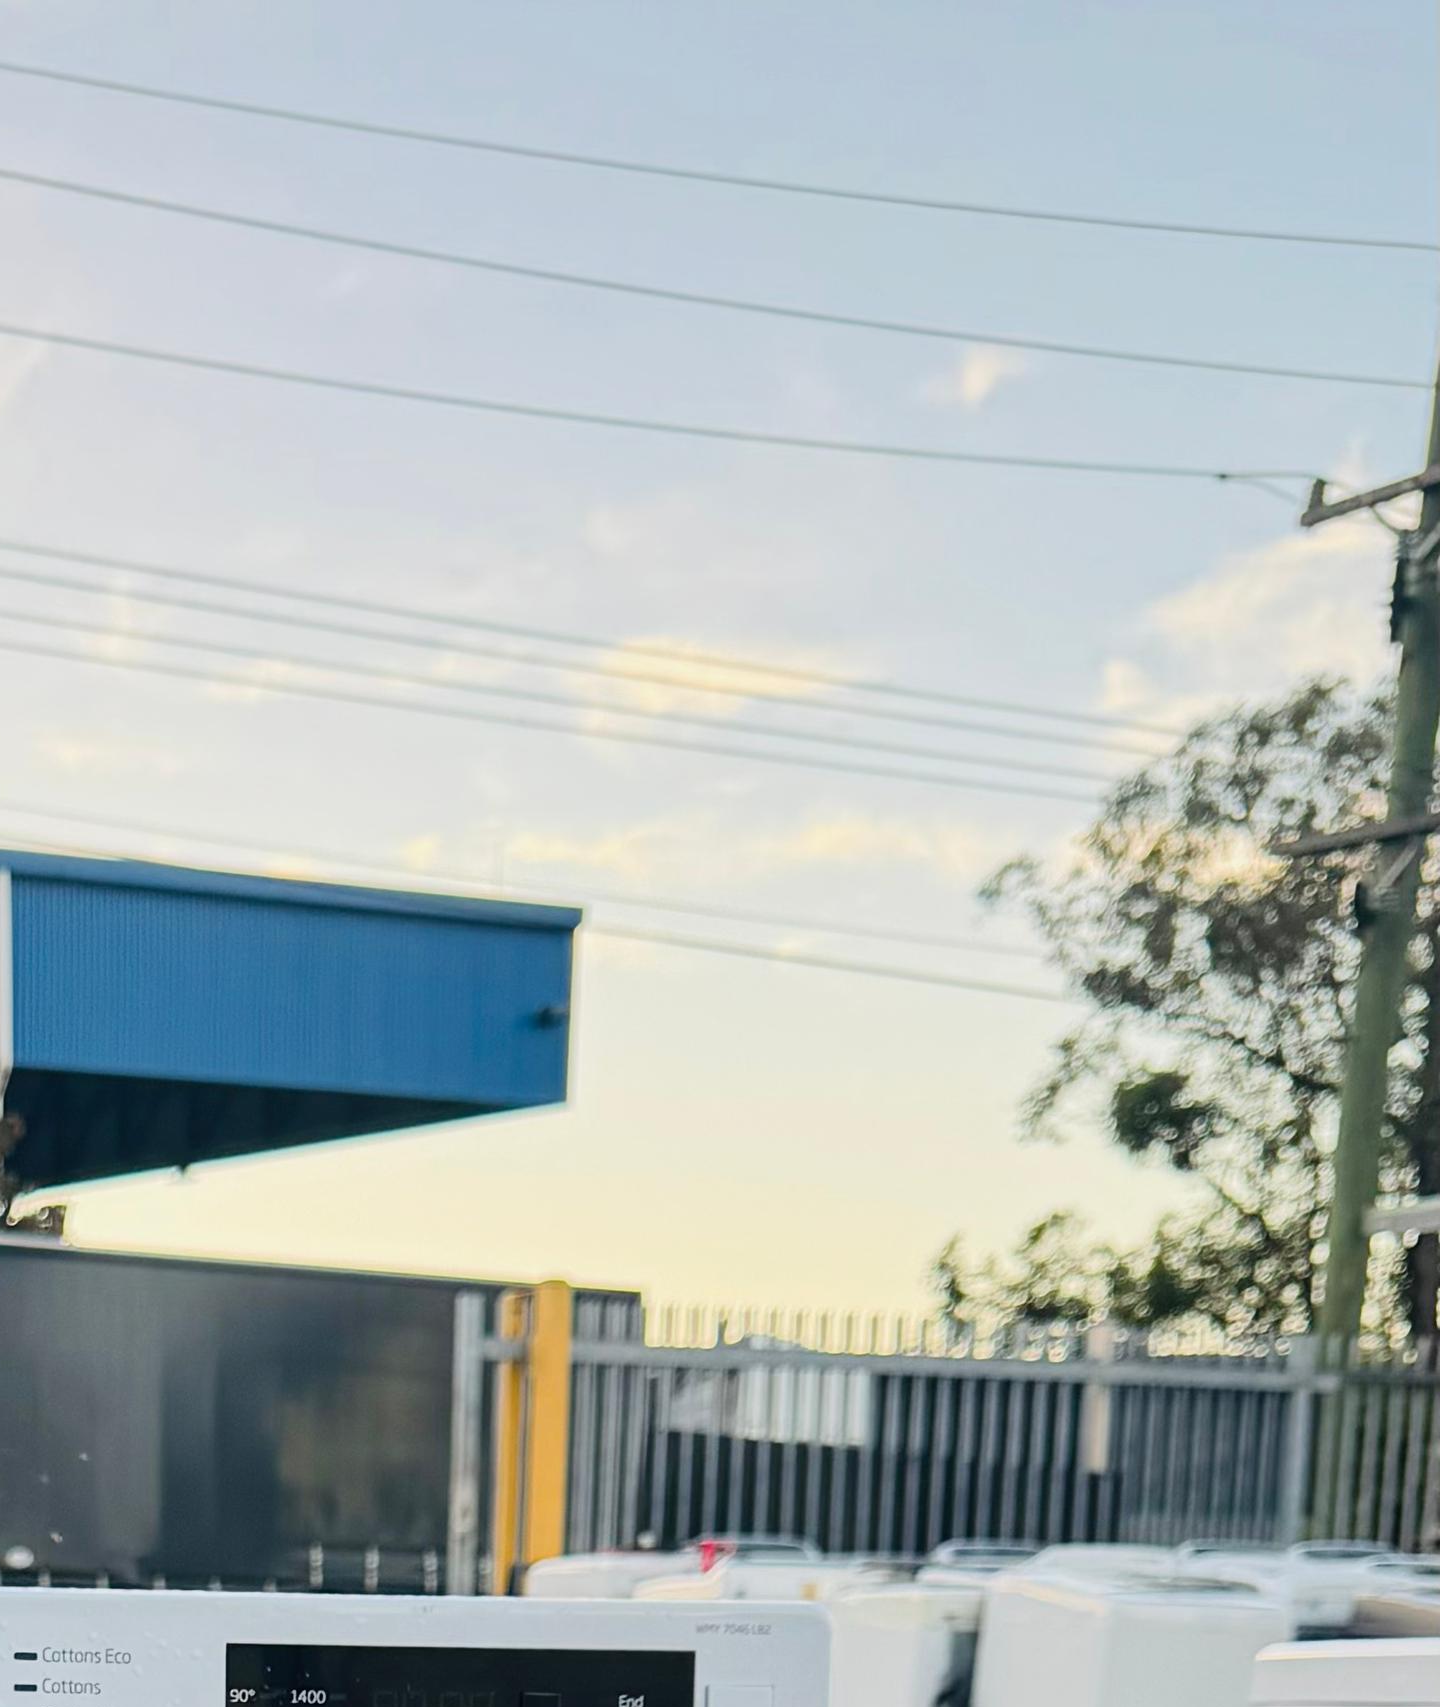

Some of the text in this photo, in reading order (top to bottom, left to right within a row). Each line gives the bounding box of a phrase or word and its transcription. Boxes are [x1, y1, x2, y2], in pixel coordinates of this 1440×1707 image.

[42, 1648, 132, 1666] Cottons Eco
[42, 1678, 102, 1695] Cottons
[290, 1689, 327, 1704] 1400
